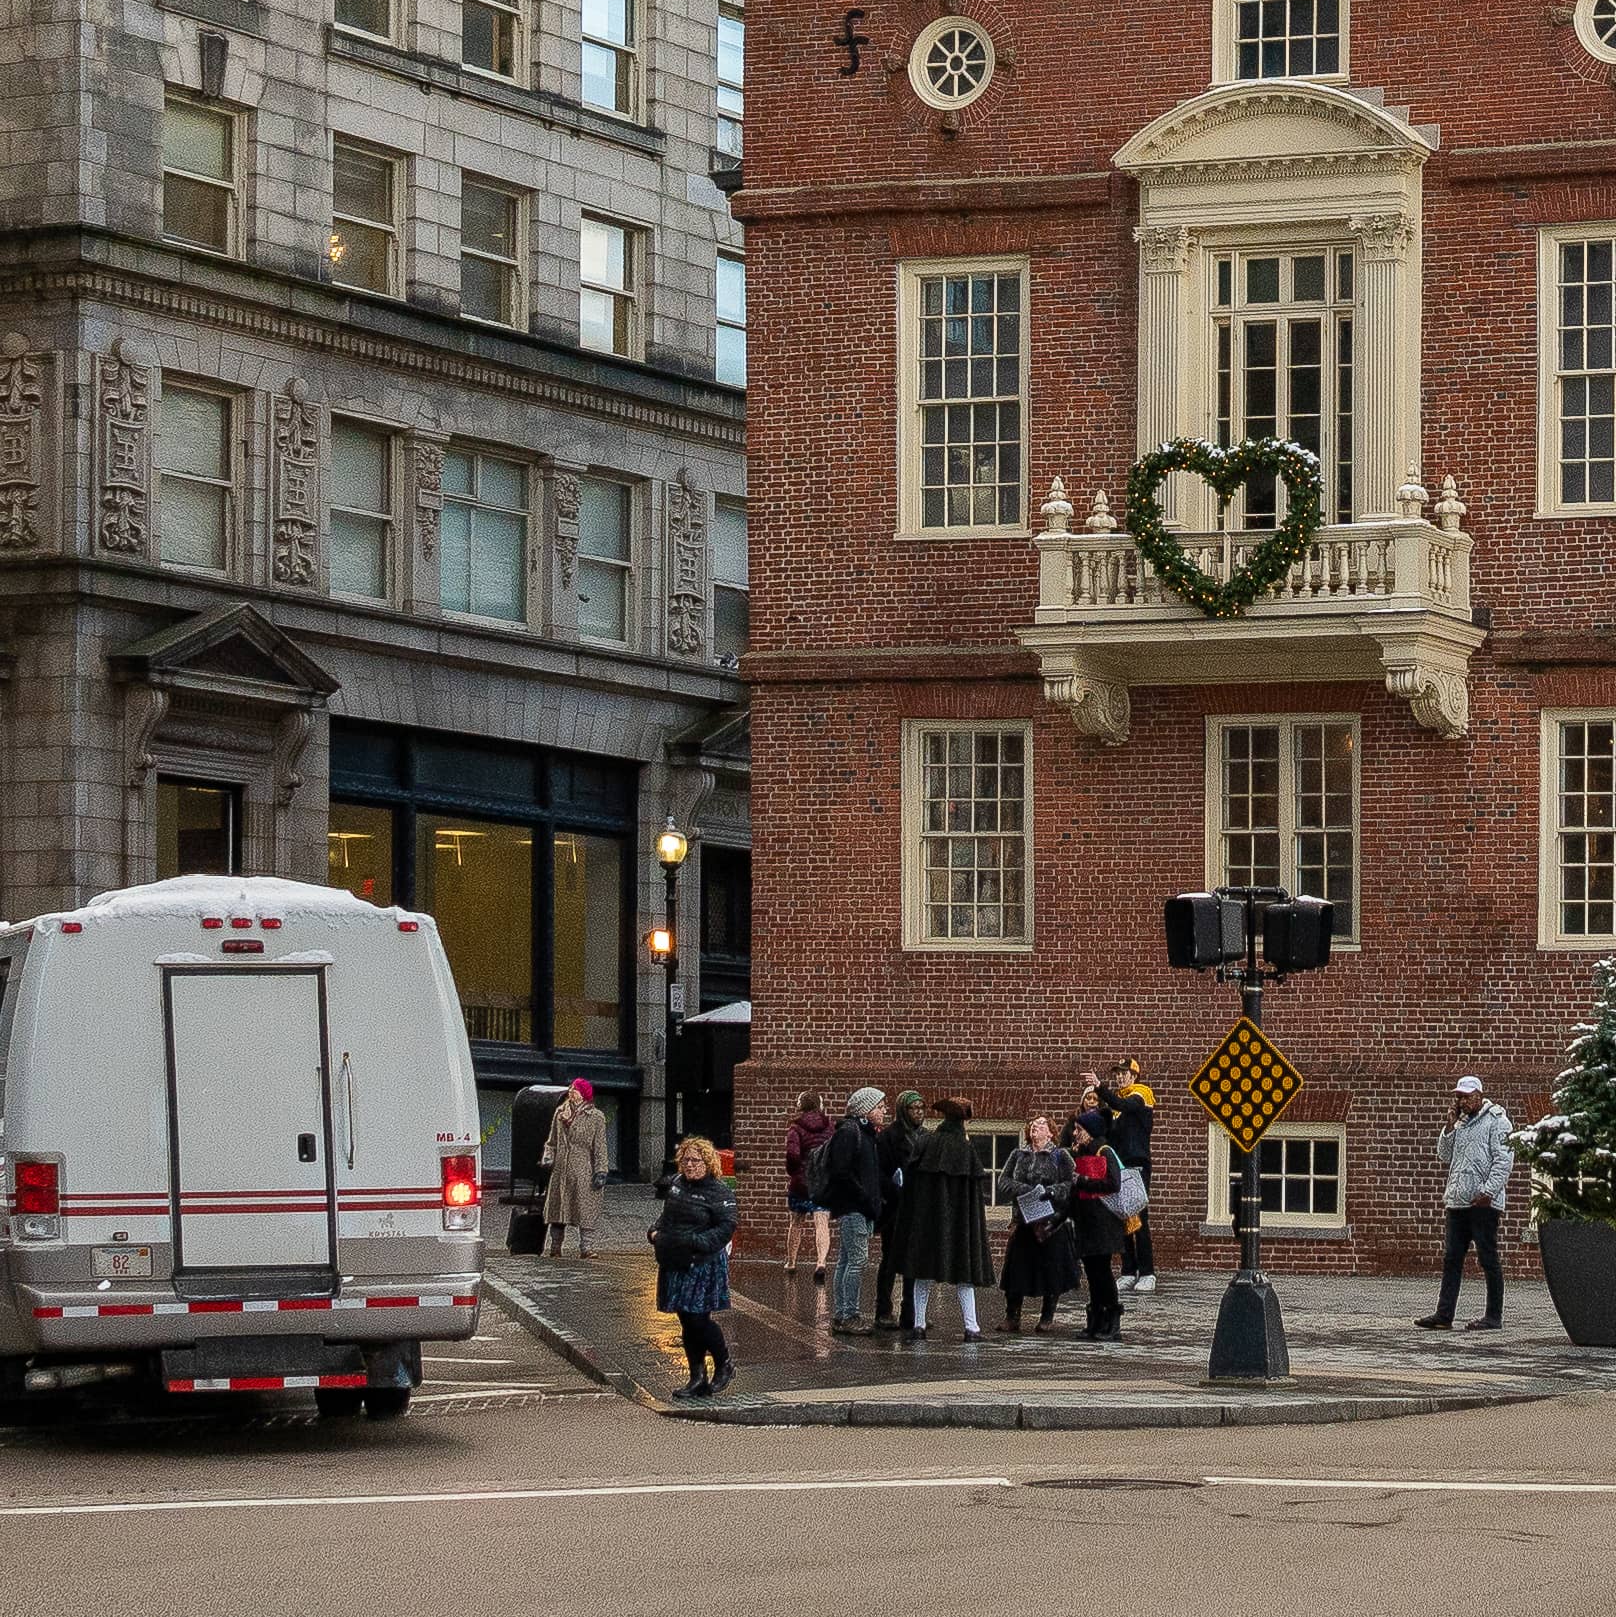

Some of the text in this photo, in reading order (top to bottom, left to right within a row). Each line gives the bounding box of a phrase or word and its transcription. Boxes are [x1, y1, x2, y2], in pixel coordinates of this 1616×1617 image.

[436, 1133, 454, 1142] MB
[463, 1133, 471, 1142] 4
[112, 1254, 130, 1270] 82
